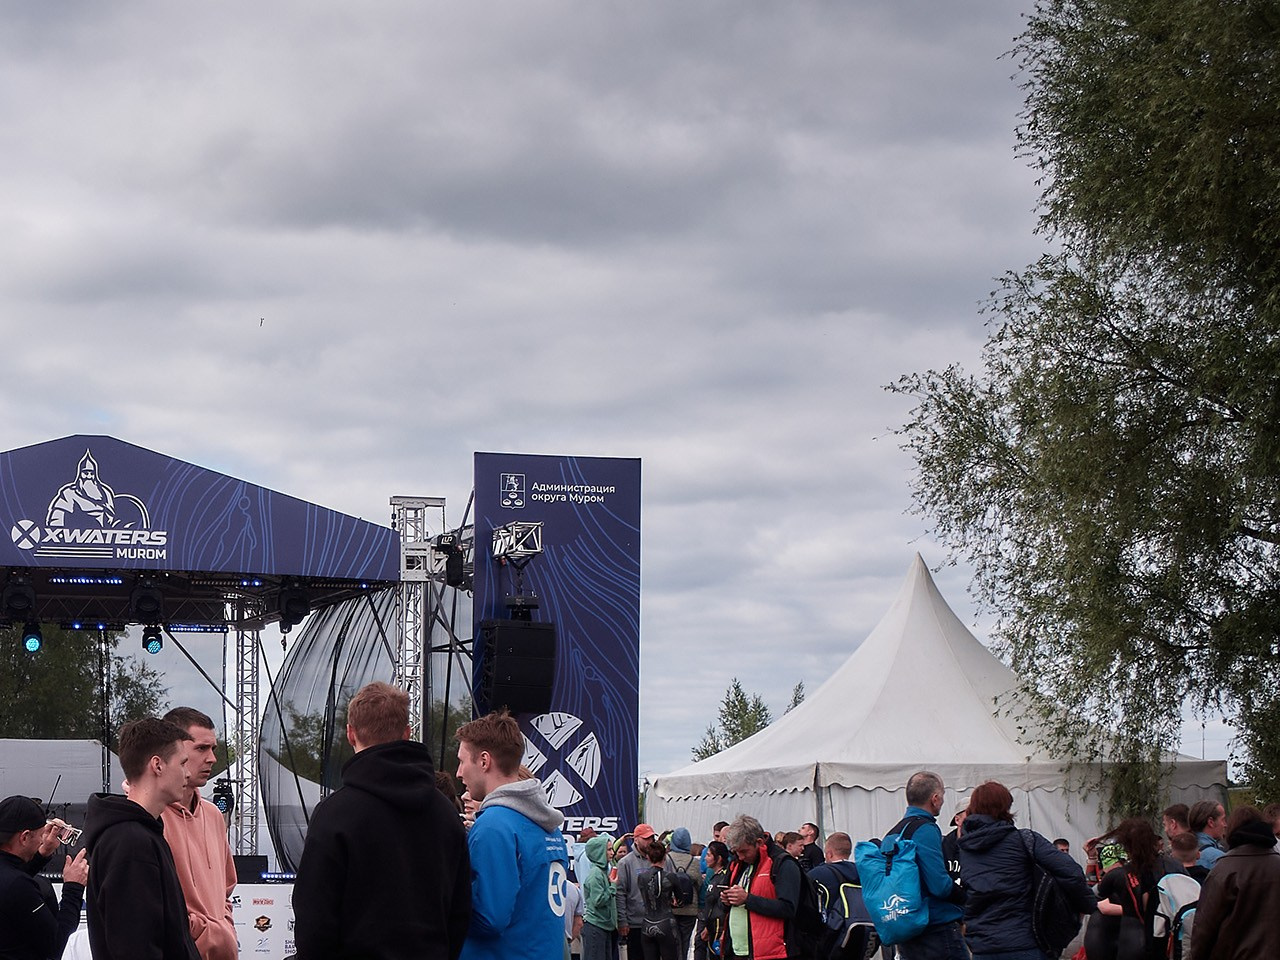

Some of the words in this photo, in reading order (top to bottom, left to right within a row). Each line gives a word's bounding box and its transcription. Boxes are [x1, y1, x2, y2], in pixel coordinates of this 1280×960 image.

[531, 482, 616, 494] Администрация
[531, 493, 567, 503] округа
[569, 493, 604, 504] Муром
[116, 548, 167, 560] MUROM
